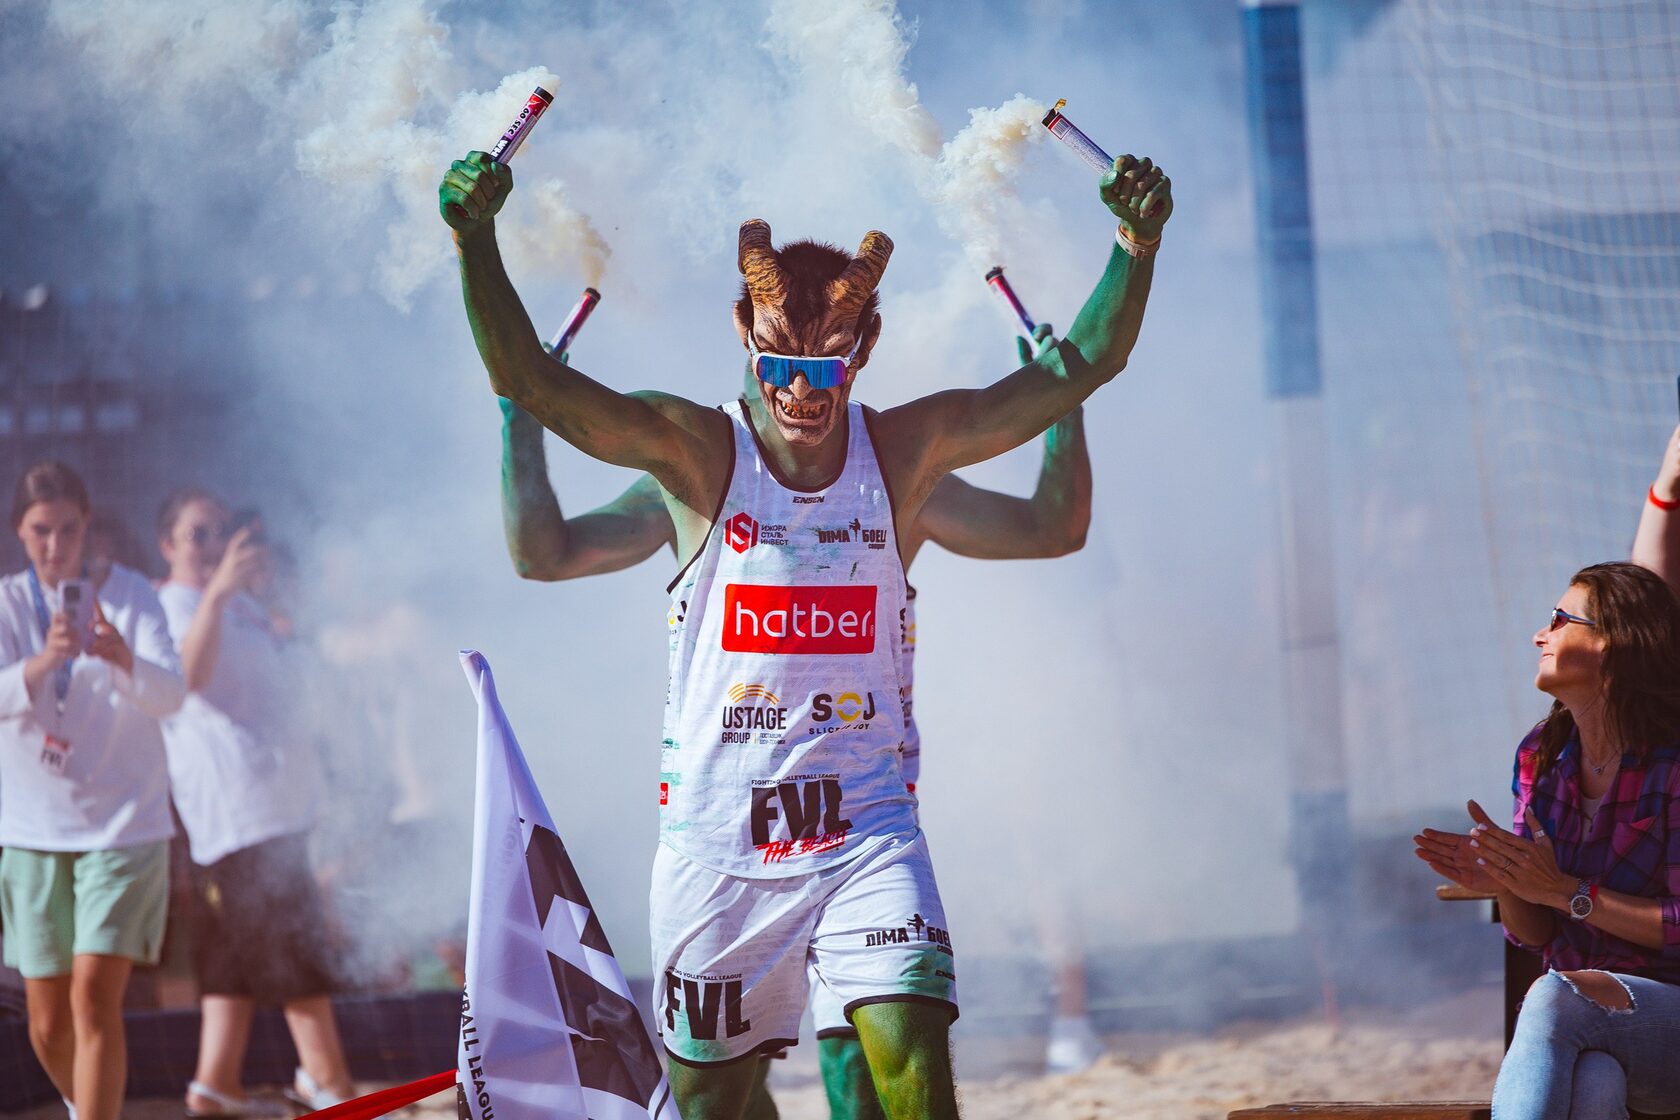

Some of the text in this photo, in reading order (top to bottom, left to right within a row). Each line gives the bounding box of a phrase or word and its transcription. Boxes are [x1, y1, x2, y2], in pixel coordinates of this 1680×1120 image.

[507, 120, 521, 135] SEC
[490, 139, 508, 157] WH
[761, 524, 787, 532] ИЖОРА
[760, 538, 789, 546] ИНВЕСТ
[735, 600, 873, 638] hatber
[722, 706, 788, 731] USTAGE
[721, 731, 751, 744] GROUP
[751, 779, 854, 846] FVL
[683, 971, 719, 981] VOLLEYBALL
[719, 973, 743, 981] LEAGUE
[665, 971, 752, 1041] FVL
